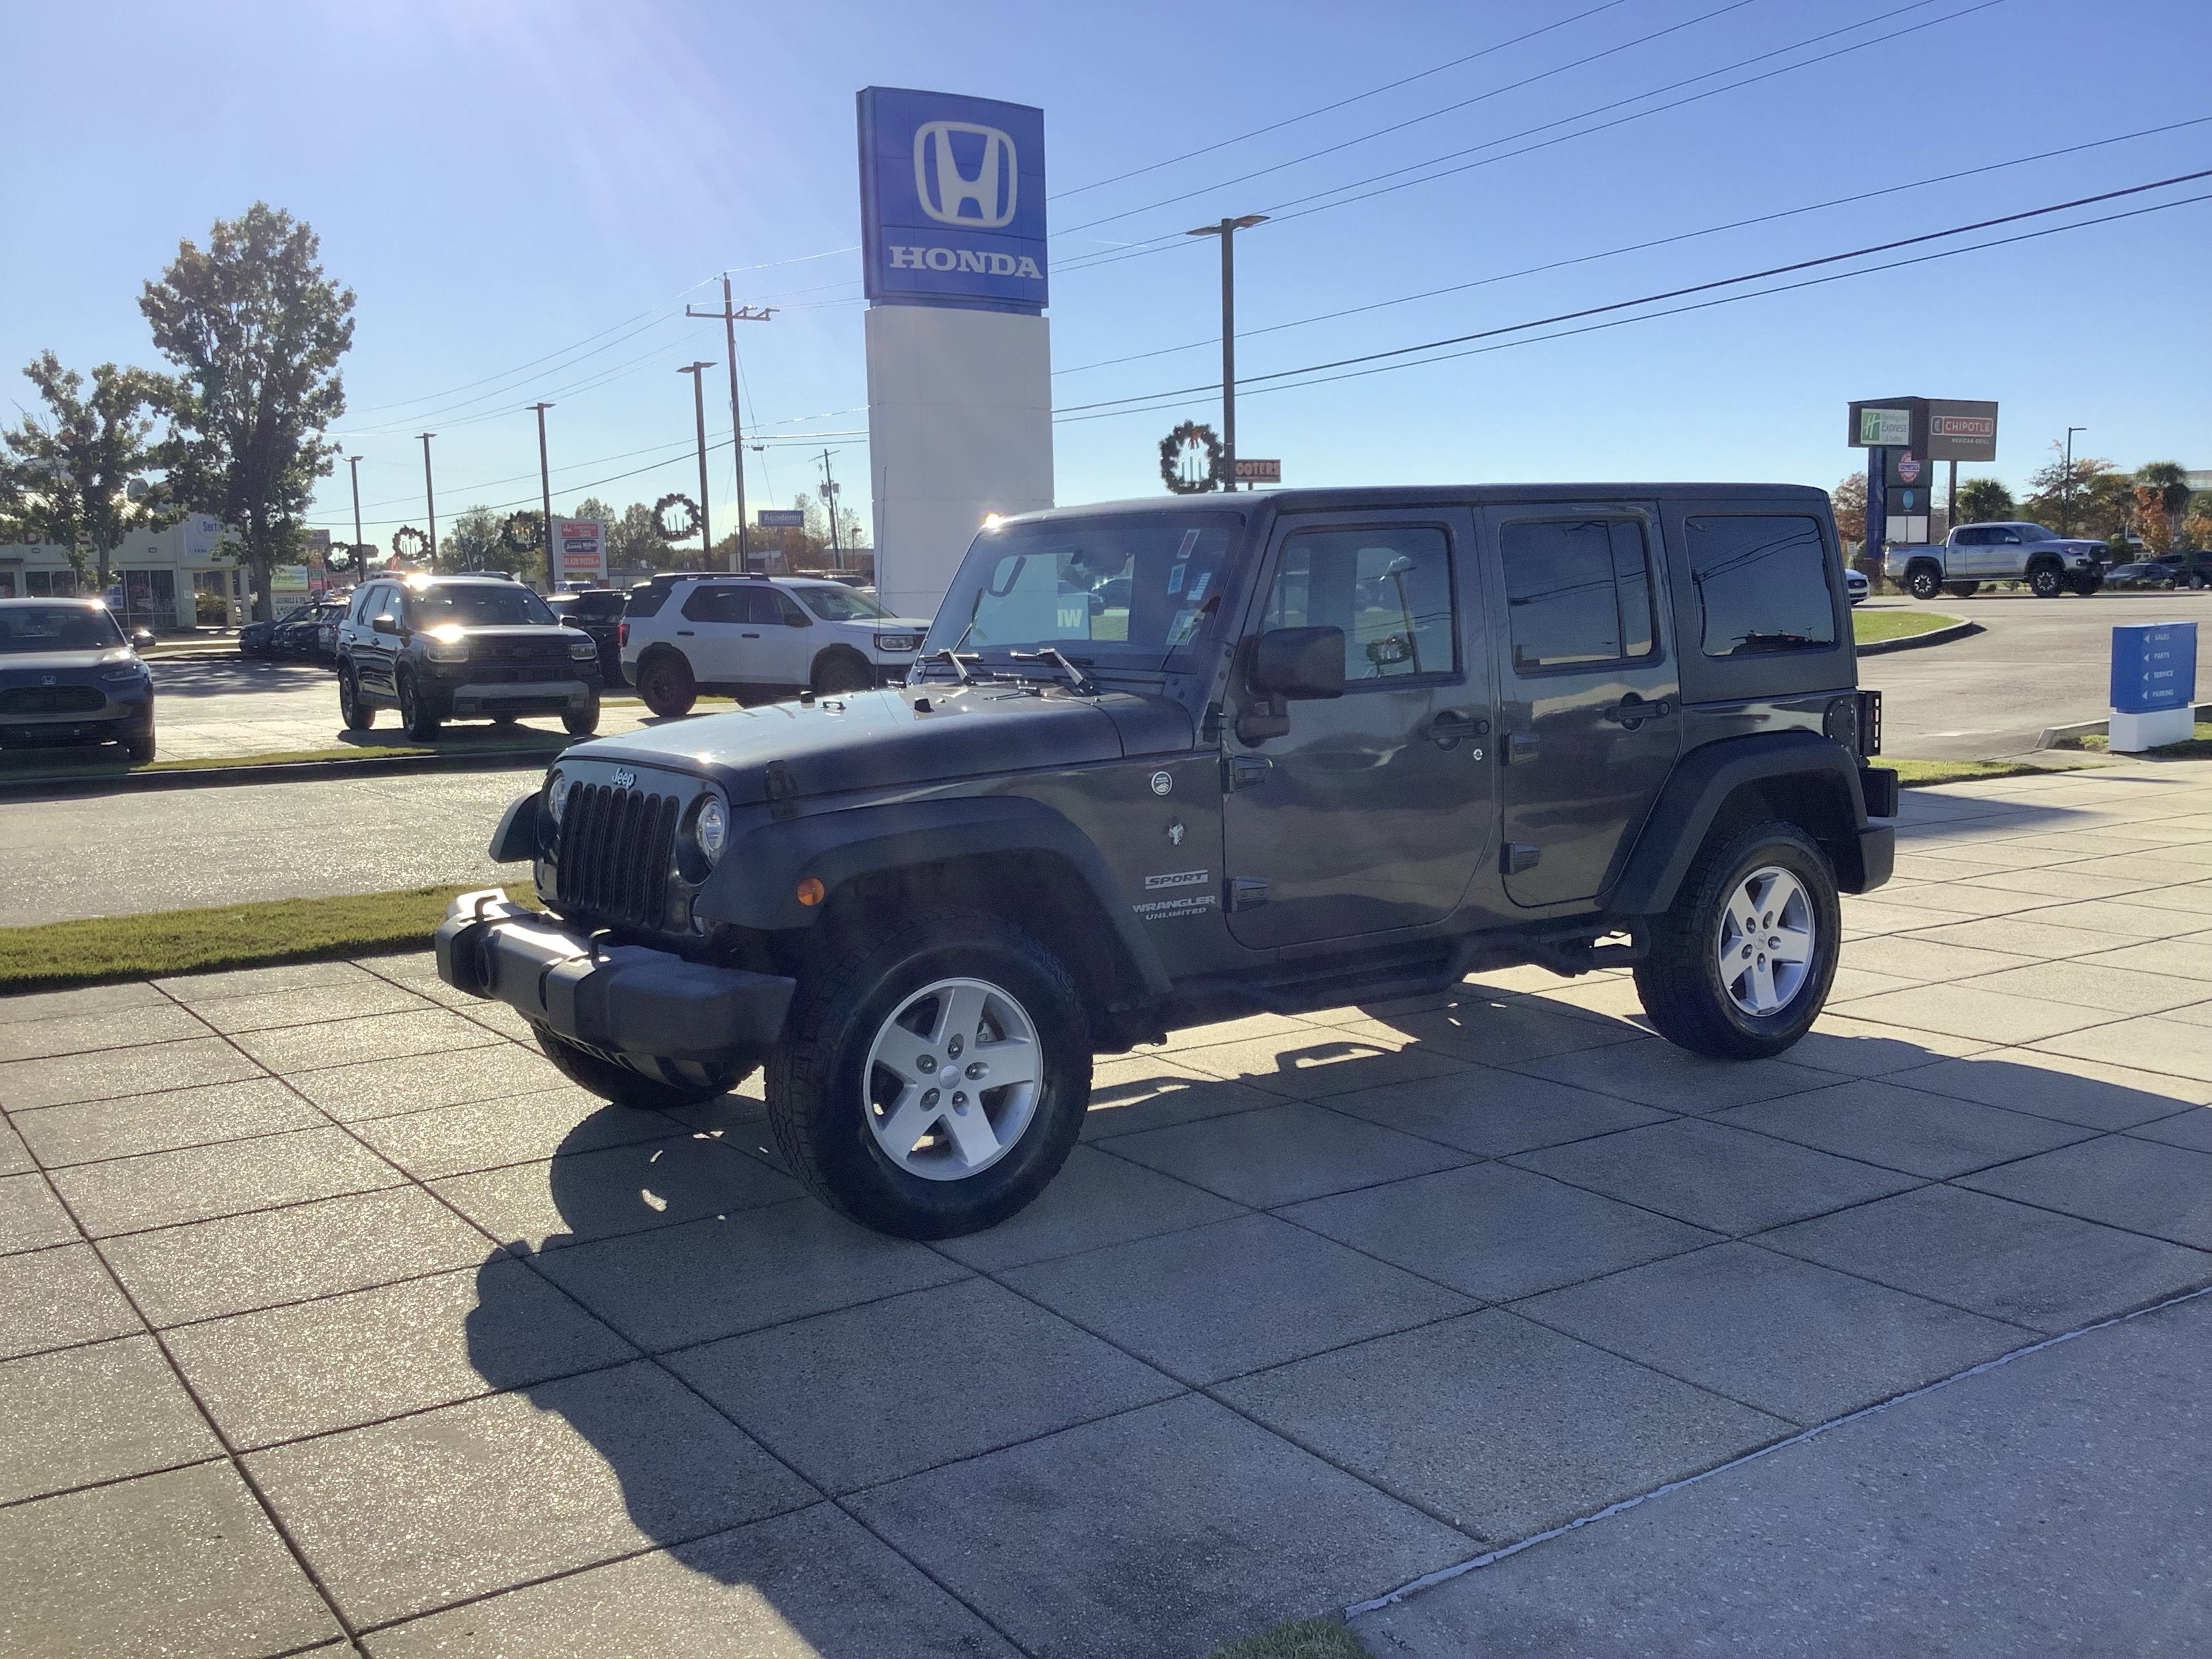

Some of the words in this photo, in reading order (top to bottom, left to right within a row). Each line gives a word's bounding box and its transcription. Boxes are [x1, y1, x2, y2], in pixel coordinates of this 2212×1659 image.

[889, 246, 1044, 279] HONDA
[1881, 422, 1907, 434] Express
[1945, 421, 1990, 432] CHIPOTLE
[1235, 462, 1280, 476] OOTERS
[764, 514, 801, 523] Academy
[2154, 670, 2174, 678] SERVICE
[2152, 689, 2174, 697] PARKING
[612, 767, 635, 790] Jeep
[1149, 873, 1204, 885] SPORT
[1132, 895, 1216, 913] WRANGLER
[1145, 907, 1206, 920] UNLIMITED
